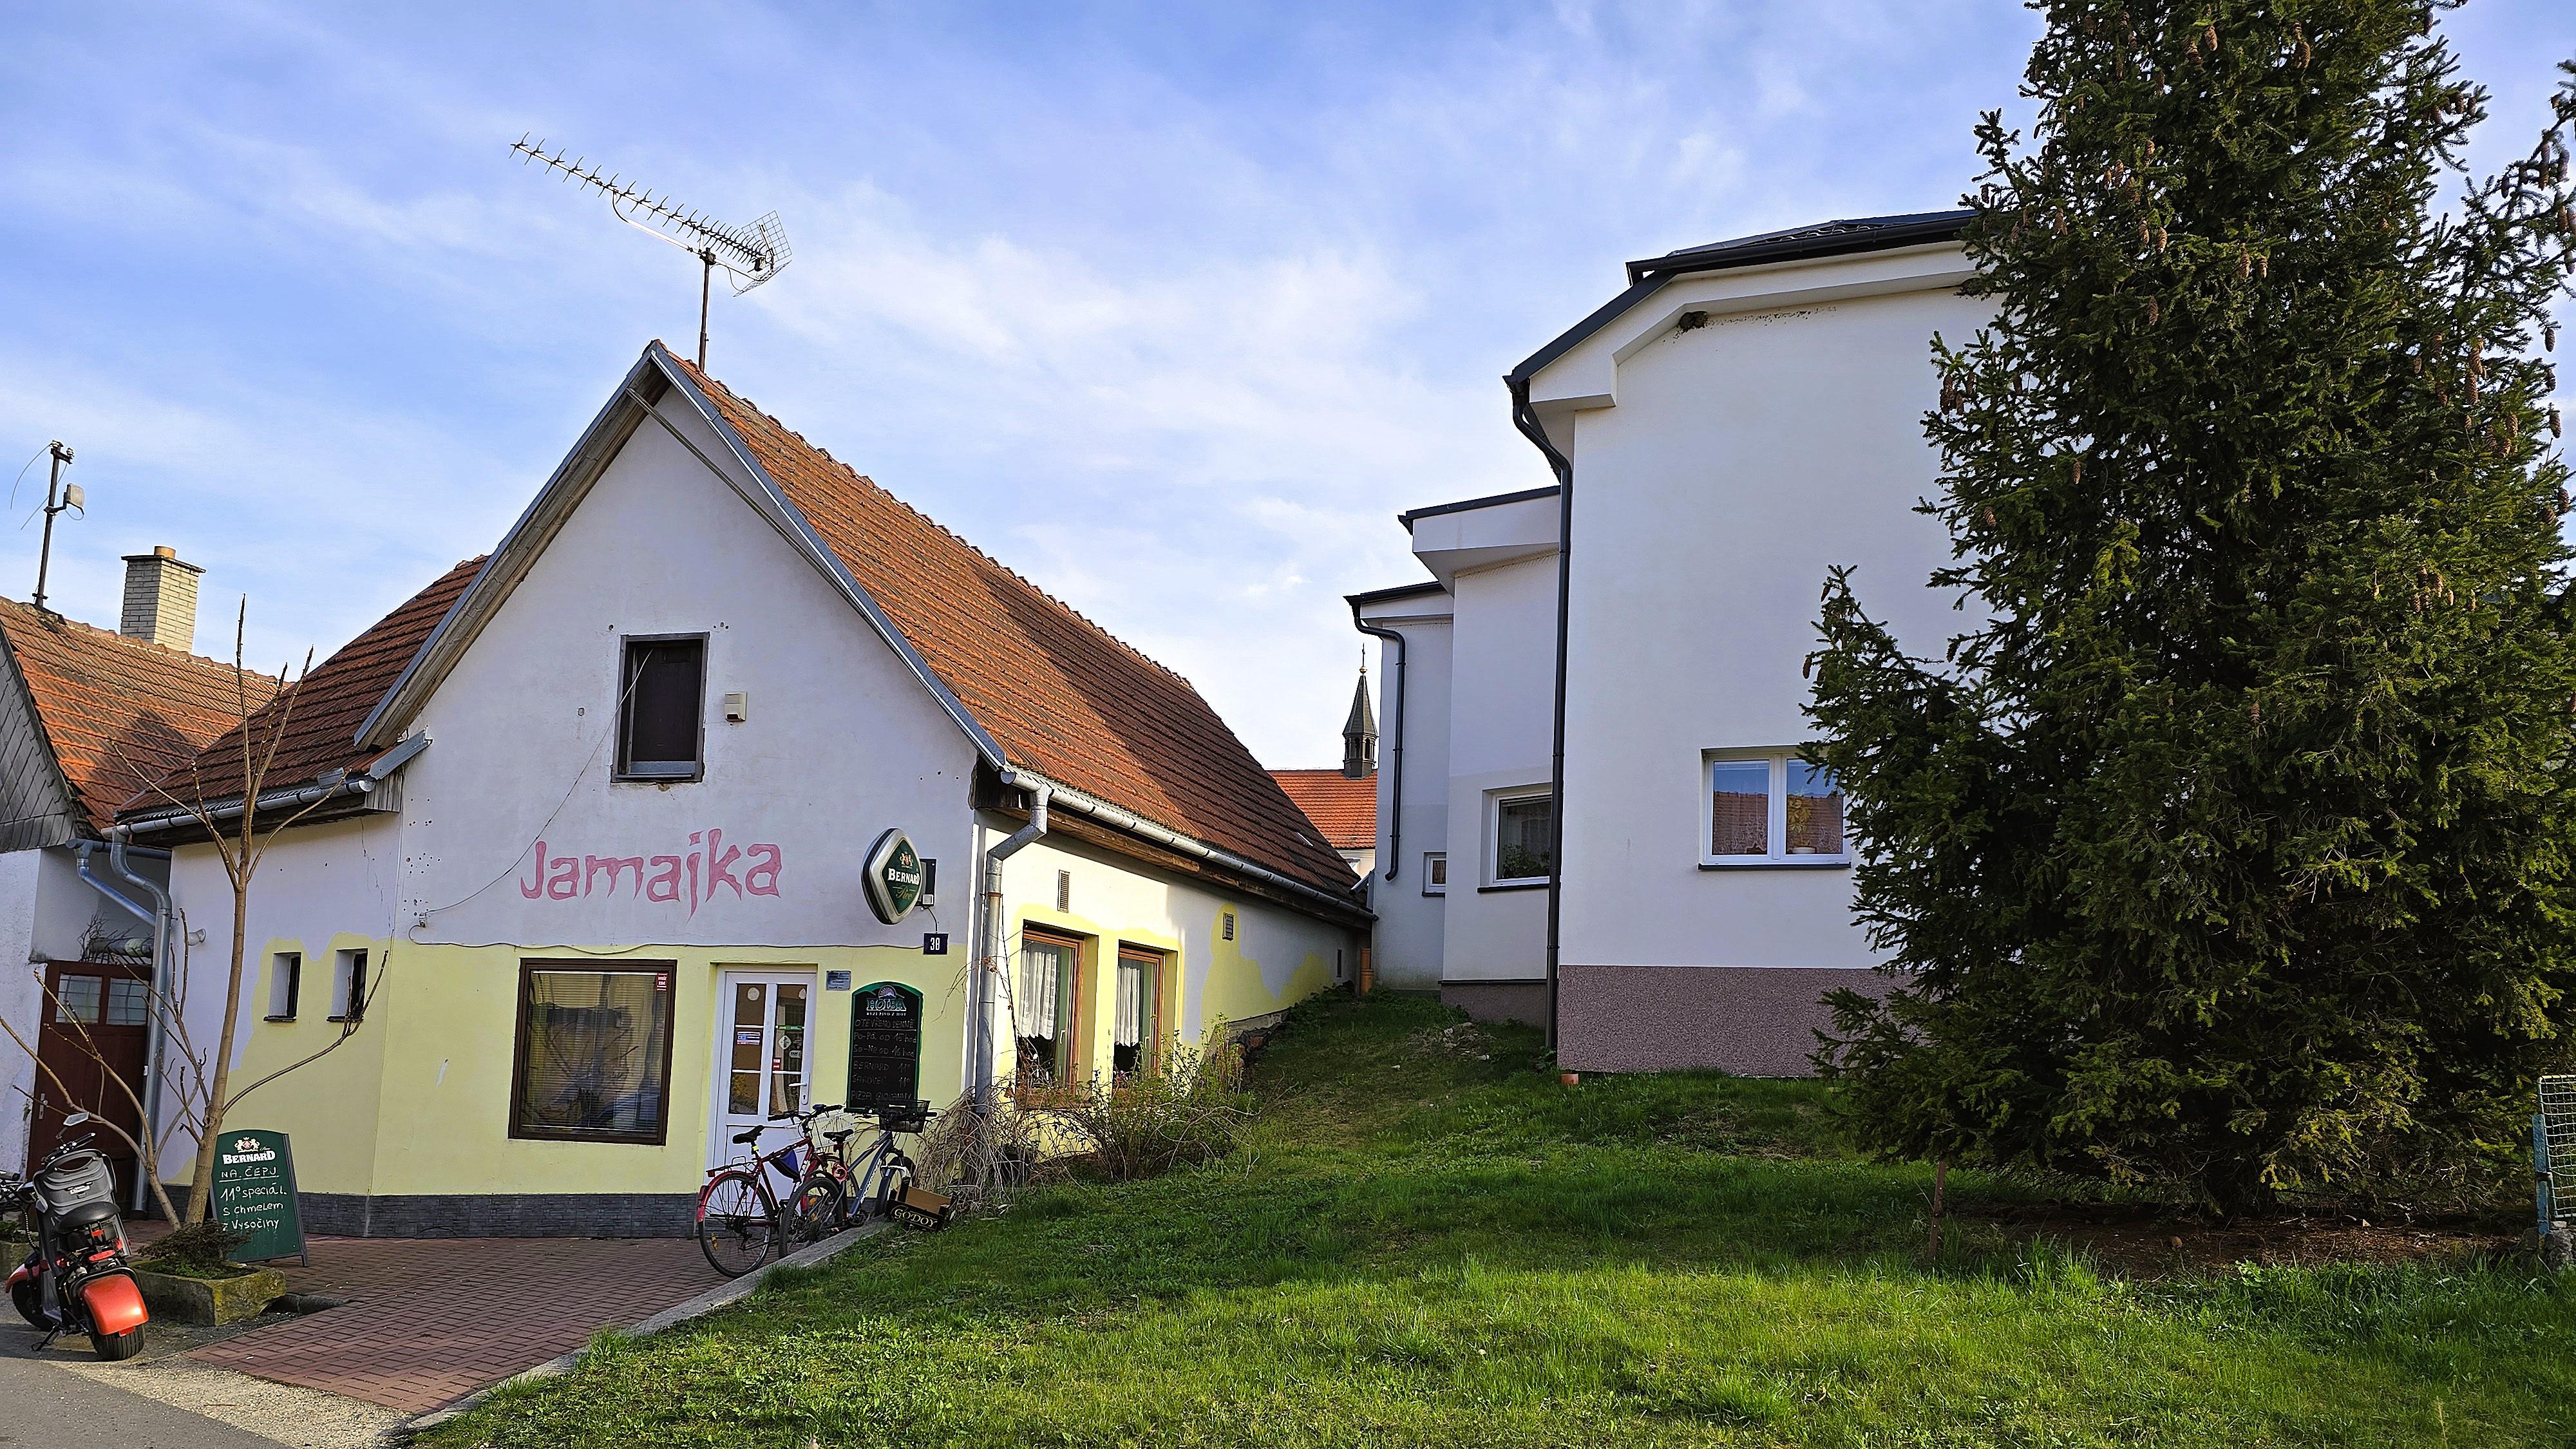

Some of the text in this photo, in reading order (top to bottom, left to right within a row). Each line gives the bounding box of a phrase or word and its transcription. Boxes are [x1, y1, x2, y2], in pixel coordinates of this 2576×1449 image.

[520, 828, 782, 923] Jamajka
[887, 867, 920, 886] BERNARD
[930, 937, 940, 951] 38
[866, 998, 907, 1012] HOLBA
[855, 1016, 914, 1028] OTEVŘENO DENNĚ
[853, 1061, 890, 1071] BERNARD
[851, 1090, 872, 1101] PIZZA
[223, 1150, 276, 1164] BERNARD
[245, 1166, 276, 1177] ČEPU
[231, 1217, 279, 1230] Vysočiny
[894, 1208, 938, 1227] GODOY
